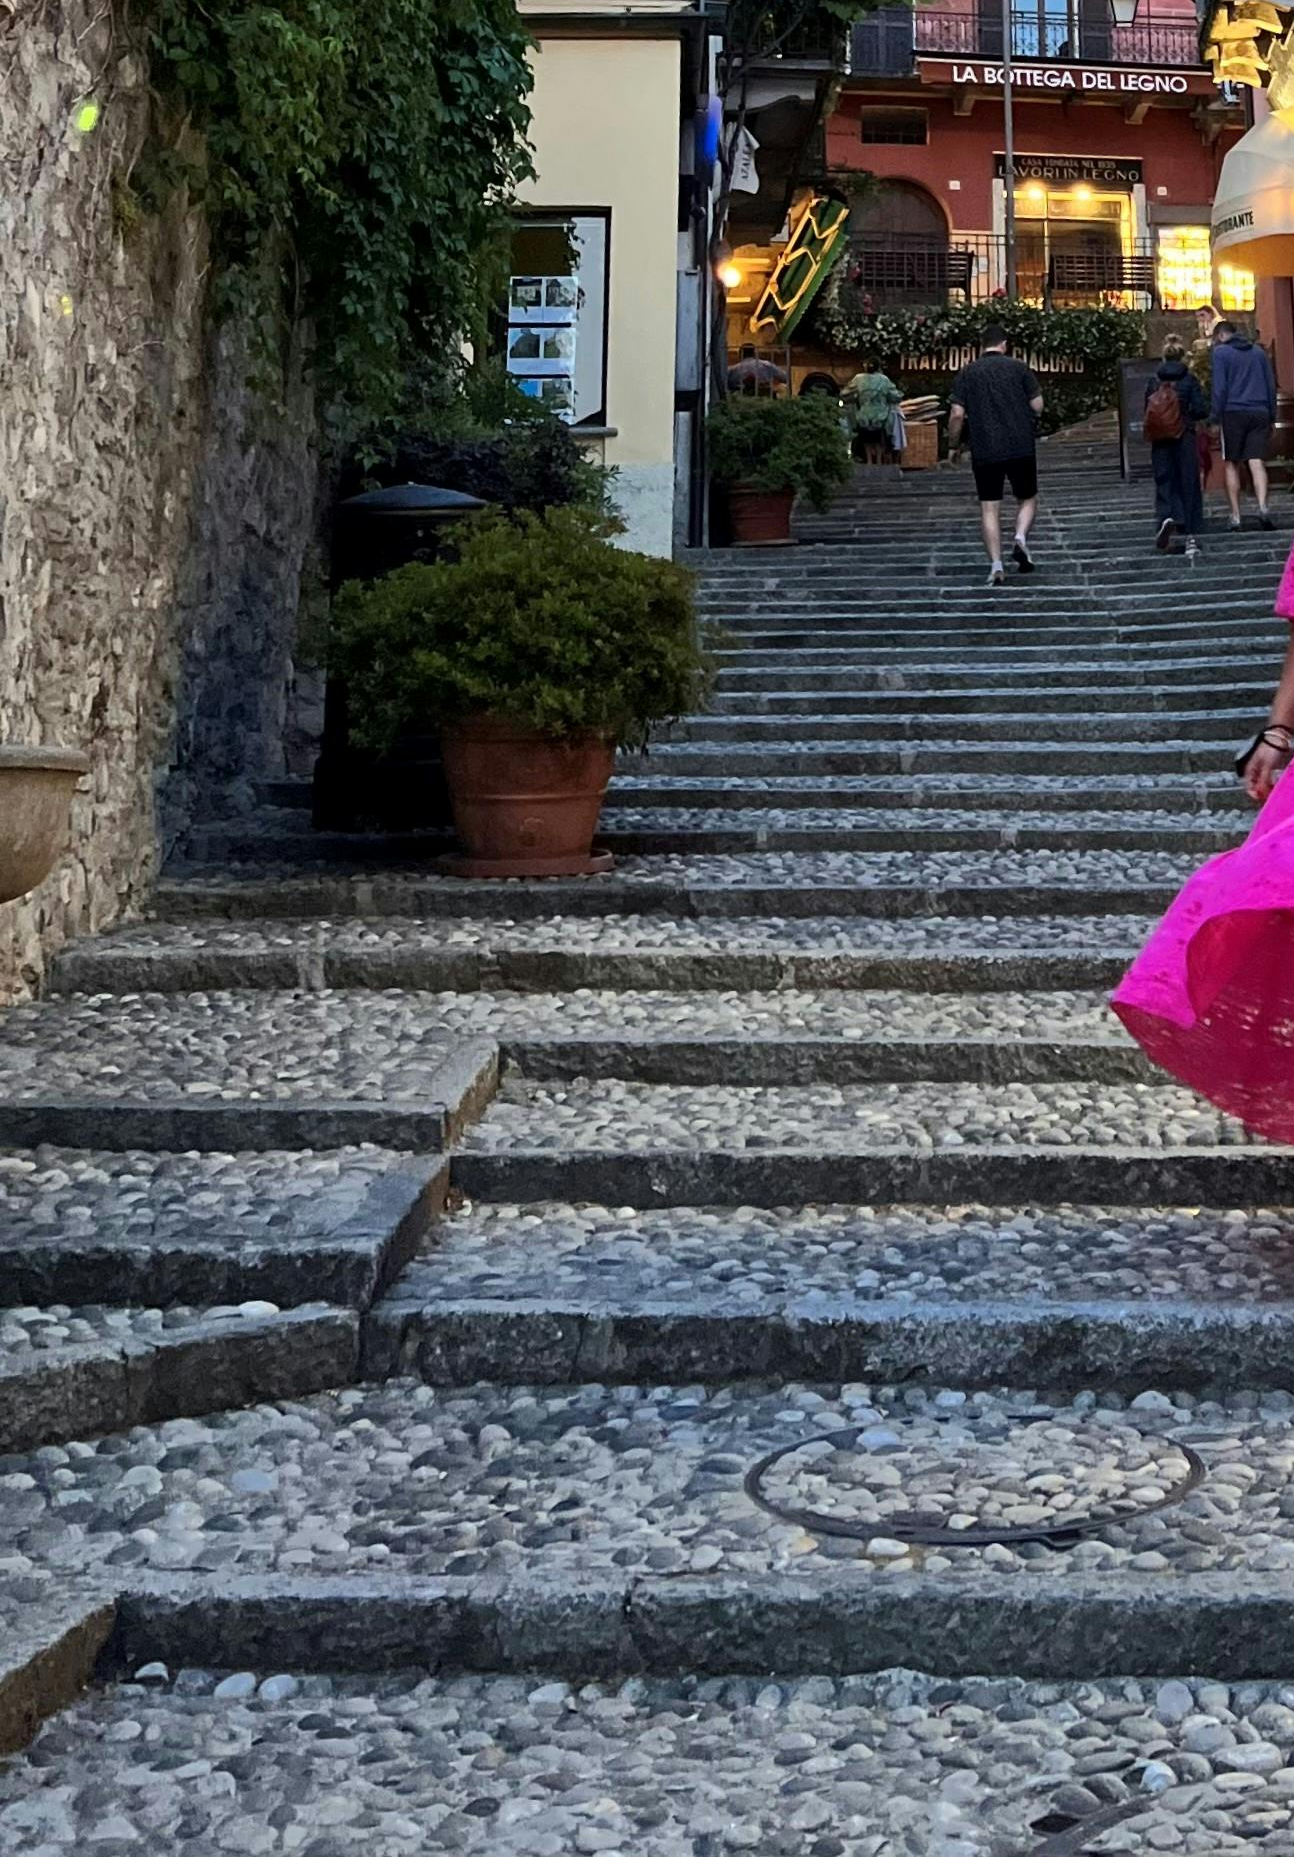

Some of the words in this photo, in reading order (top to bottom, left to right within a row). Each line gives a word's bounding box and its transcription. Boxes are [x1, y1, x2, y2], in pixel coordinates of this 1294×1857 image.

[952, 65, 978, 83] LA
[983, 67, 1075, 88] BOTTEGA
[1082, 72, 1116, 90] DEL
[1120, 74, 1188, 93] LEGNO
[1063, 167, 1081, 179] IN
[1083, 169, 1140, 182] LEGNO
[900, 346, 981, 371] TRATTORI
